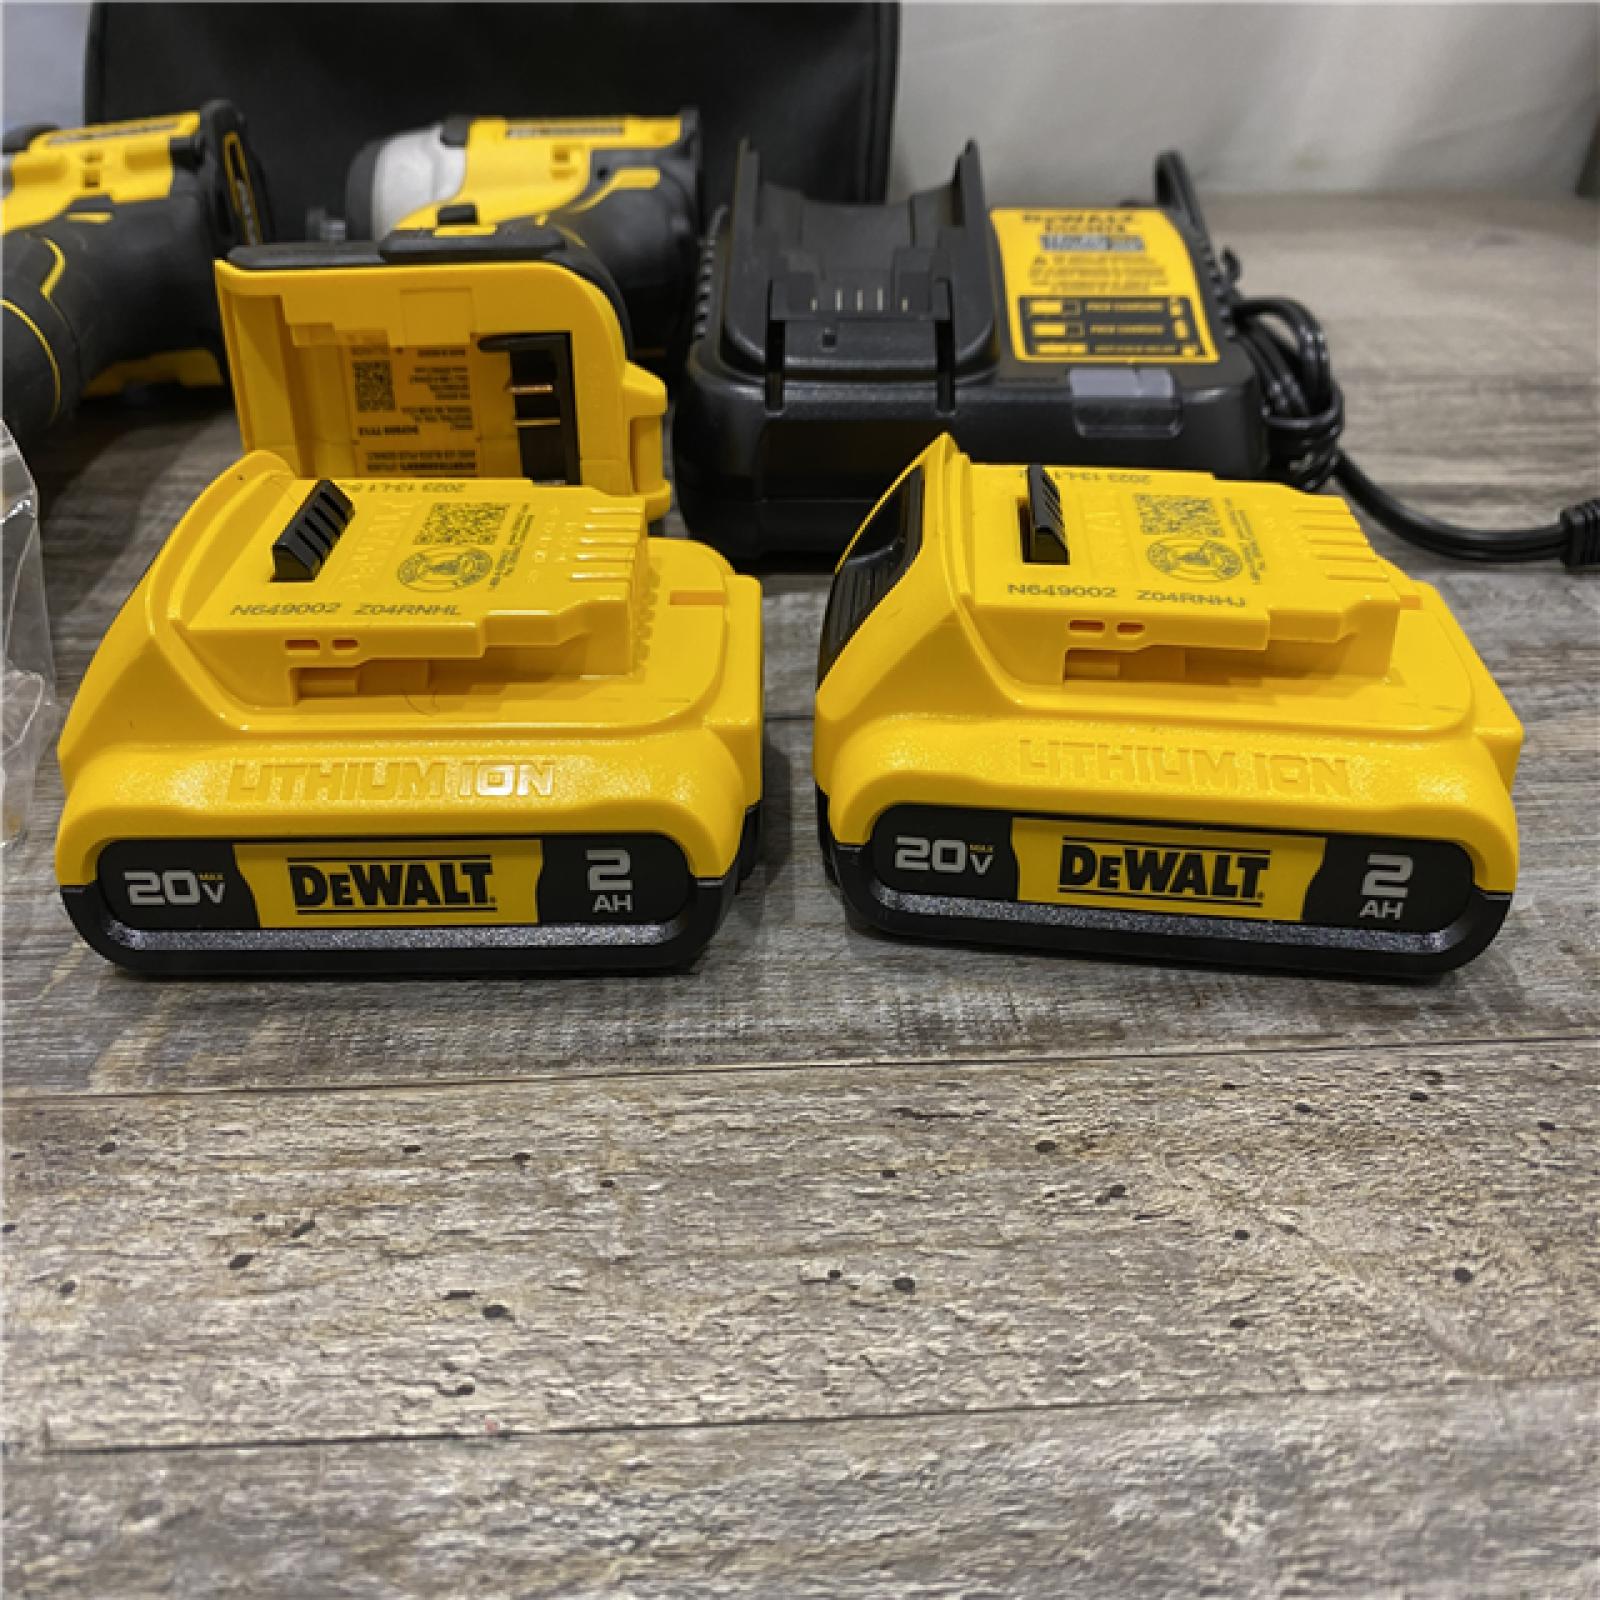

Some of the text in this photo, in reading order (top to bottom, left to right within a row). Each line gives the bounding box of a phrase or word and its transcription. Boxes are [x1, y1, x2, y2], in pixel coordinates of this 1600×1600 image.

[226, 759, 556, 801] LITHIUM ION
[1019, 738, 1353, 798] LITHIUM ION
[289, 862, 497, 910] DEWALT
[586, 849, 633, 891] 2
[1057, 843, 1271, 901] DEWALT
[1361, 853, 1413, 899] 2
[592, 894, 633, 913] AH
[1359, 899, 1404, 921] AH
